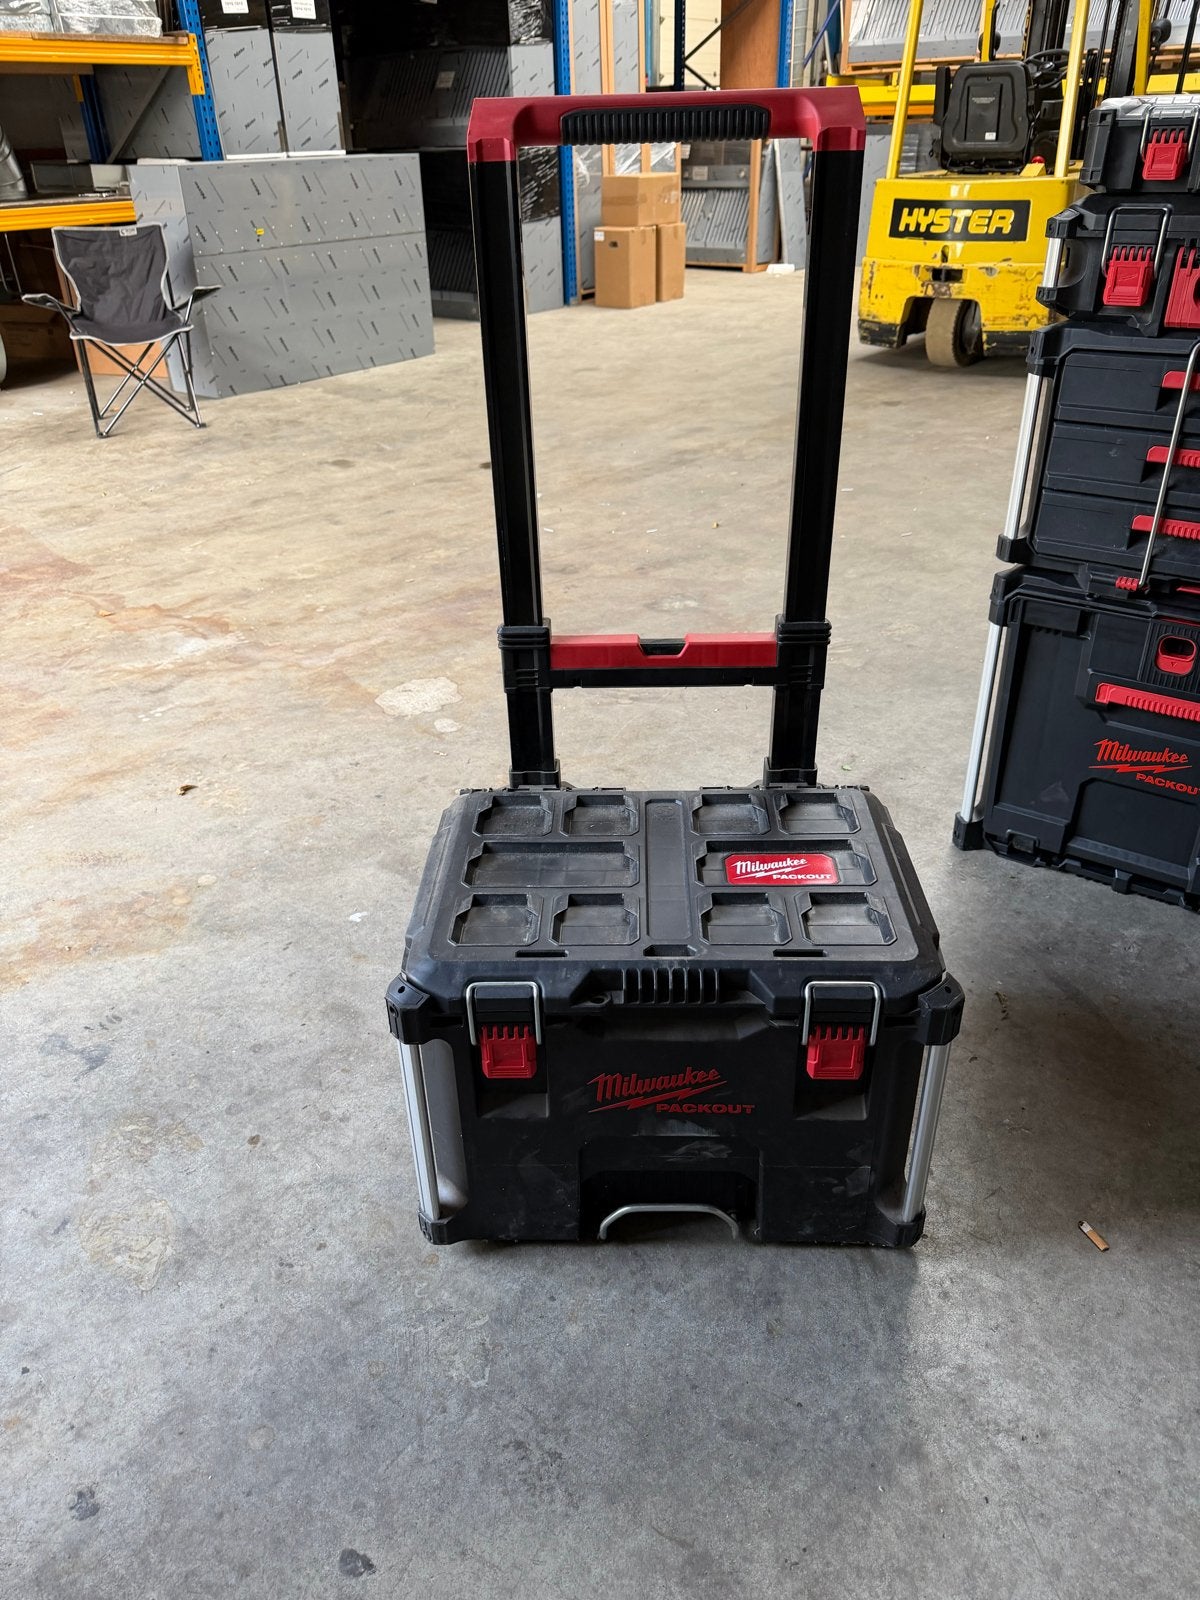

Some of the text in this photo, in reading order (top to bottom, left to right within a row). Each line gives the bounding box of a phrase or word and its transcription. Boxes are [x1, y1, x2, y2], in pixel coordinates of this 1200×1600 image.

[898, 207, 1015, 234] HYSTER
[1093, 738, 1189, 763] Milwaukee
[1135, 772, 1200, 795] PACKOU
[731, 857, 808, 875] Milwaukee
[586, 1066, 721, 1102] Milwaukee
[656, 1103, 755, 1114] PACKOUT
